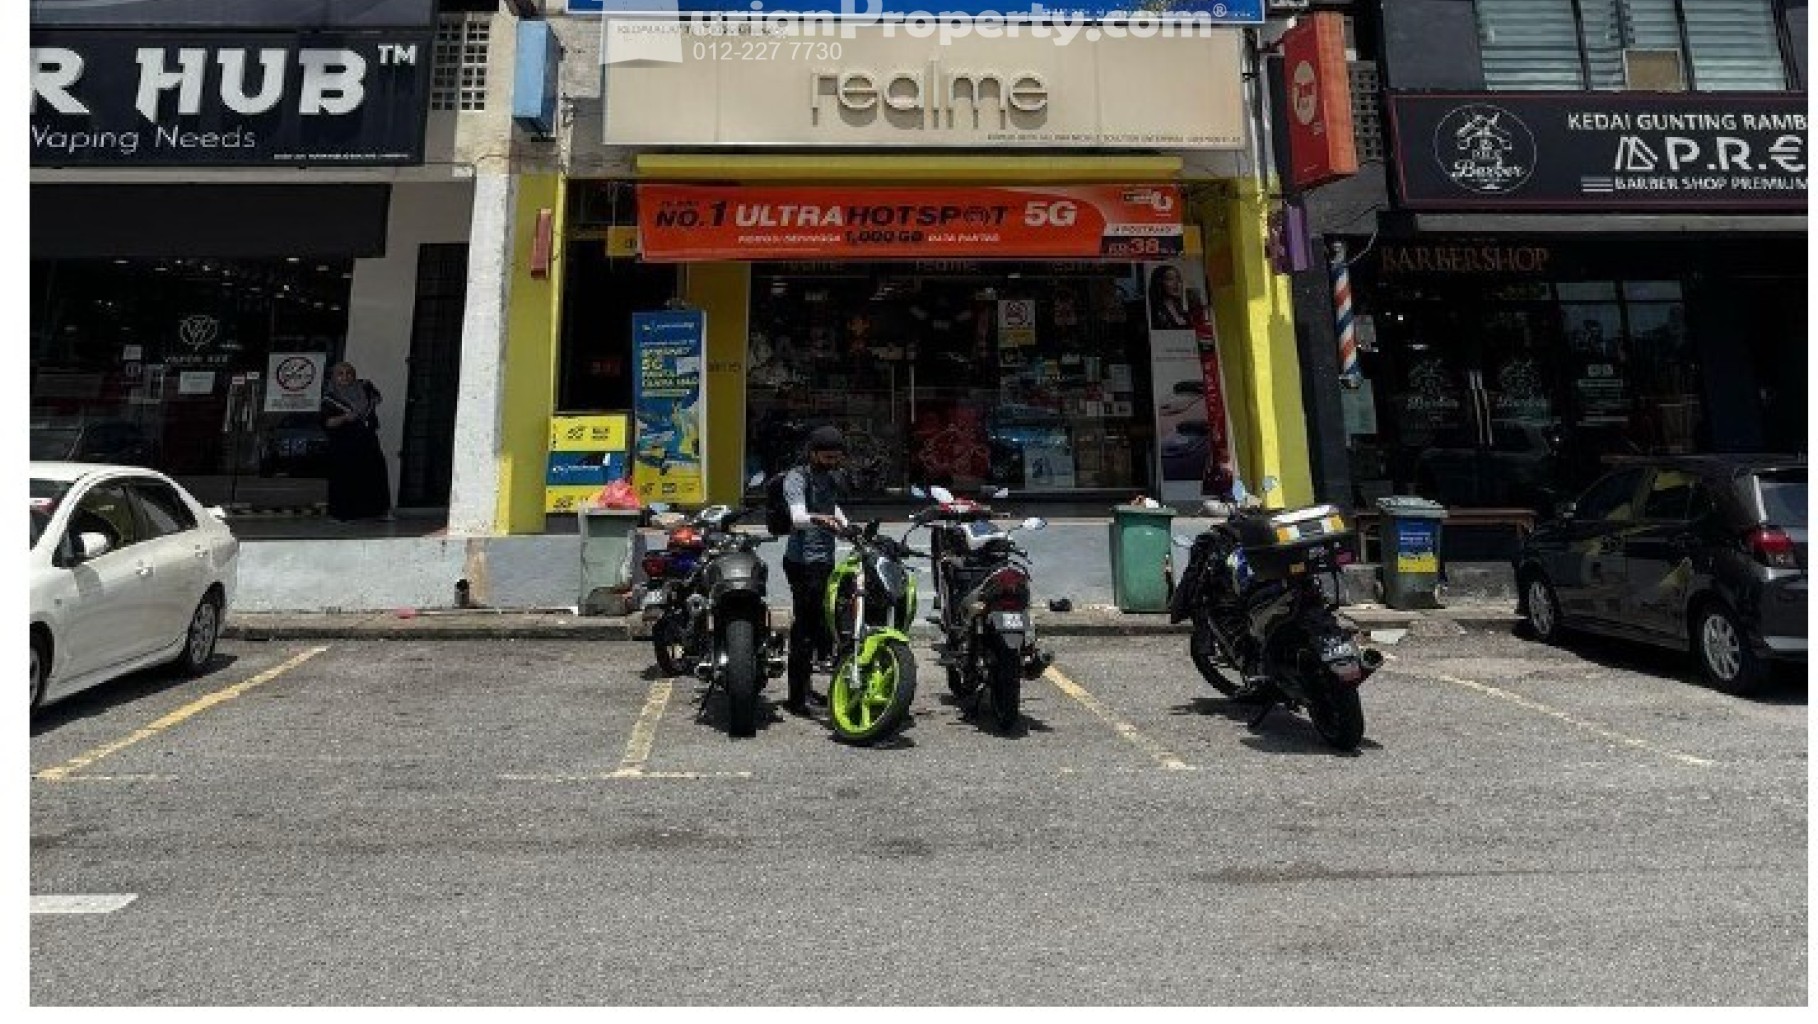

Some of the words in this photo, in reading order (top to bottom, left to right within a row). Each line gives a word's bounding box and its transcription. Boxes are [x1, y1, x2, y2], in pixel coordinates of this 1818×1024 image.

[811, 59, 1048, 122] realme
[1568, 113, 1631, 131] KEDAI
[1637, 113, 1738, 131] GUNTING
[31, 124, 139, 155] Vaping
[155, 124, 256, 149] Needs
[1614, 177, 1679, 191] BARBER
[1682, 177, 1726, 191] SHOP
[1024, 200, 1078, 227] 5G
[1380, 246, 1550, 273] BARBERSHOP
